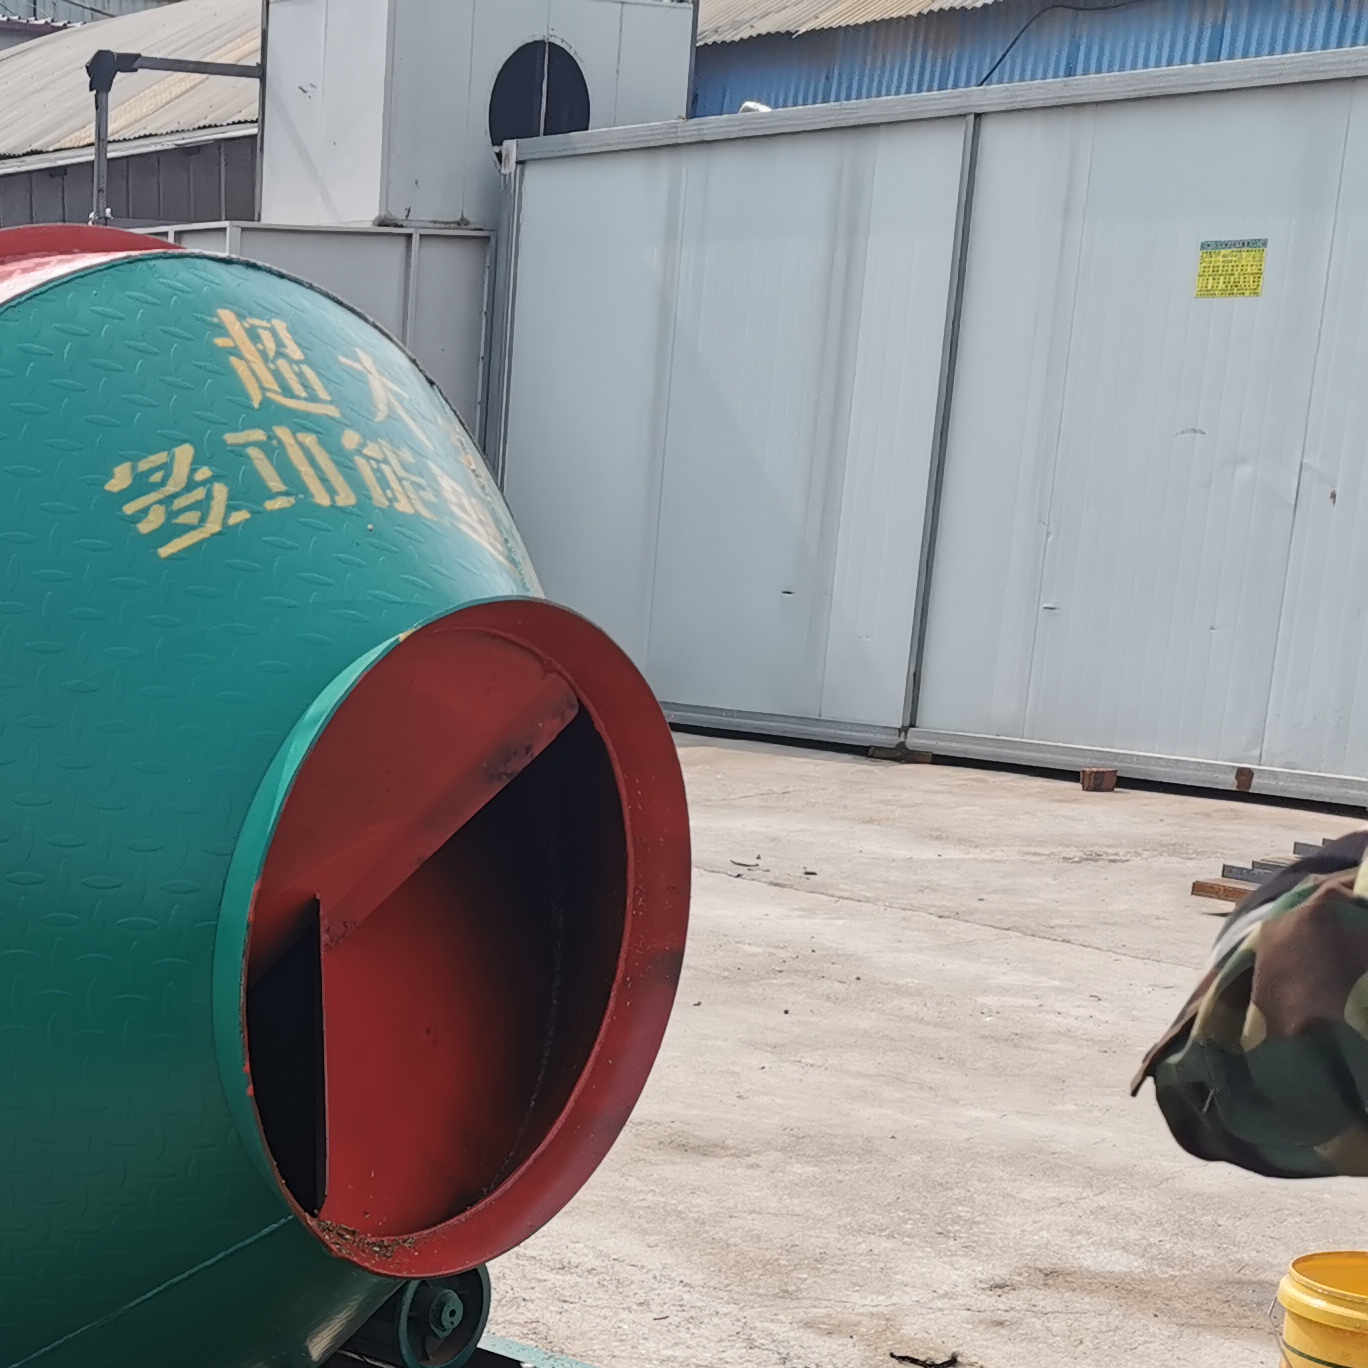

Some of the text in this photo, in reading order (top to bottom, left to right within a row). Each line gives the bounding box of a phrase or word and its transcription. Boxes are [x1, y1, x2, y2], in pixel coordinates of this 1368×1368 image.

[214, 309, 489, 490] 超大
[105, 426, 519, 577] 多功能
